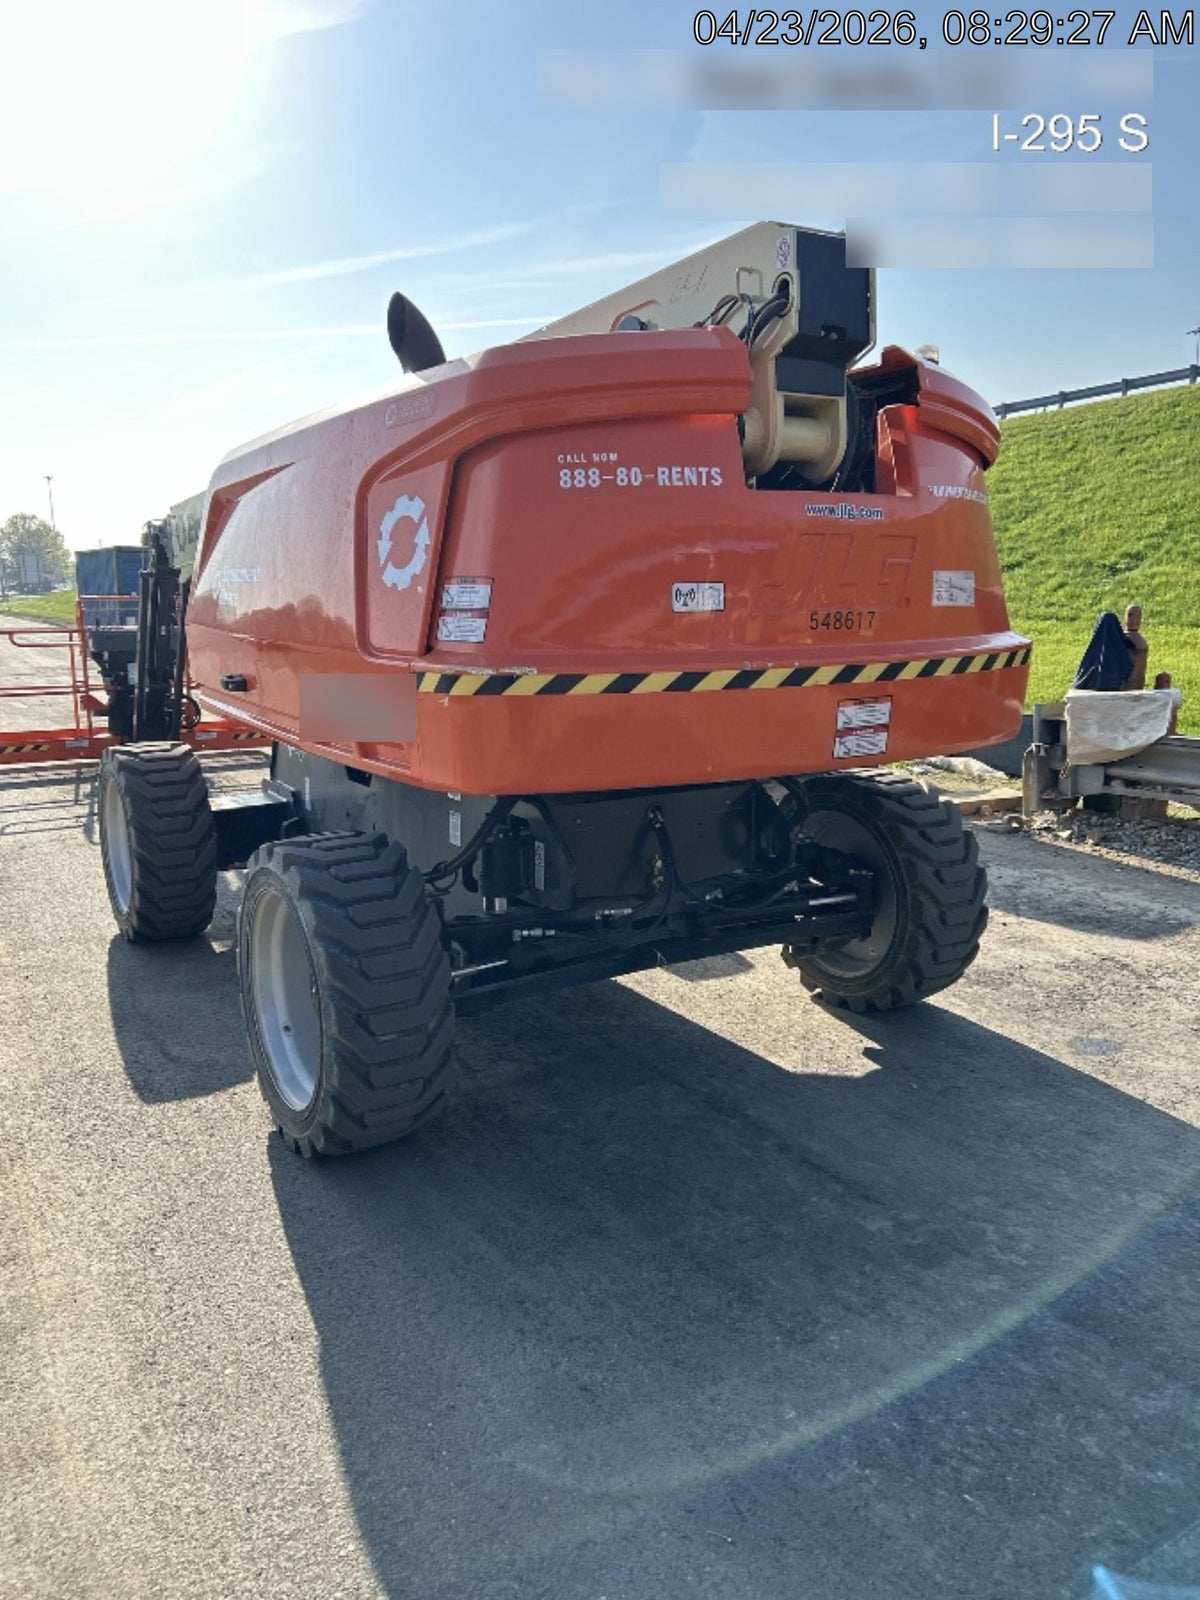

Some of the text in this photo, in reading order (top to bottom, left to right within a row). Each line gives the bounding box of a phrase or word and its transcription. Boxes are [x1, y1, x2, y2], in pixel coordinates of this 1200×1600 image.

[557, 452, 619, 464] CALL NOW
[559, 466, 723, 488] 888-80-RENTS
[805, 502, 885, 521] www.jlg.com
[809, 610, 876, 630] 548617
